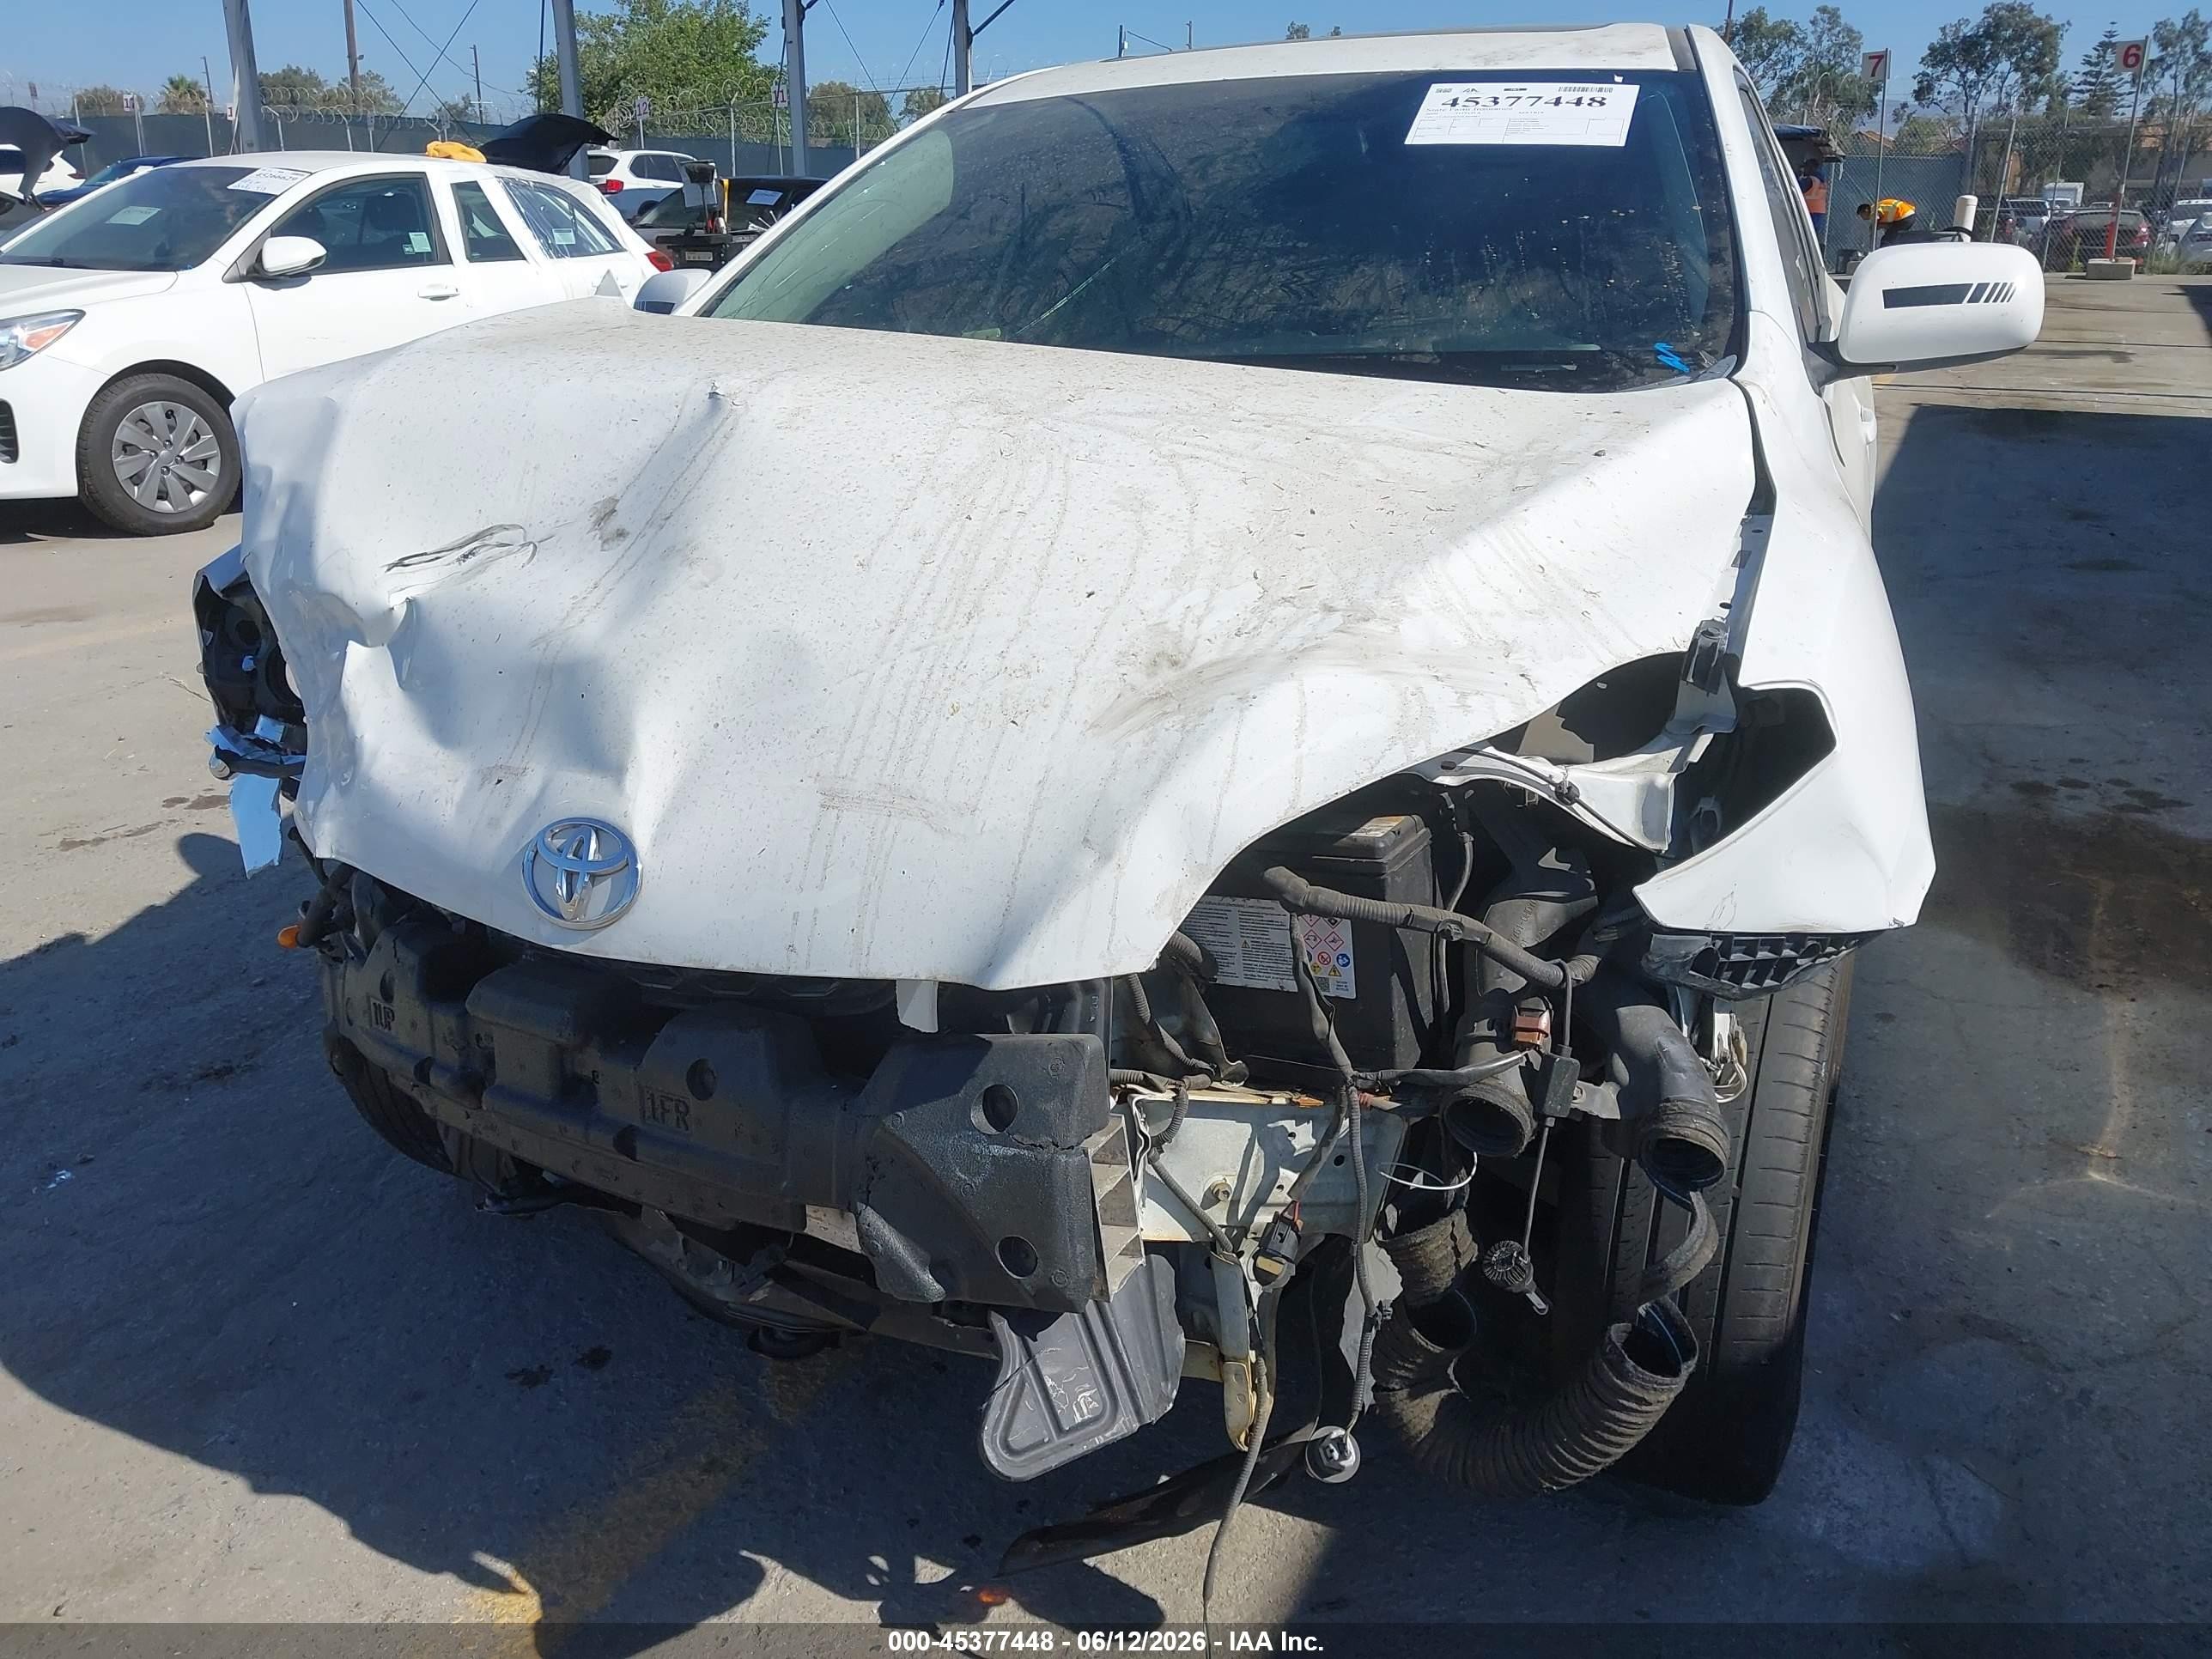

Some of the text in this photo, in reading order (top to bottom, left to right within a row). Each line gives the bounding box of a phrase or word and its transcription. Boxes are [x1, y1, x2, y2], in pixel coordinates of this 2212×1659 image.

[1868, 54, 1885, 78] 7
[2122, 43, 2142, 69] 6
[636, 101, 648, 117] 12
[1441, 96, 1607, 108] 45377448
